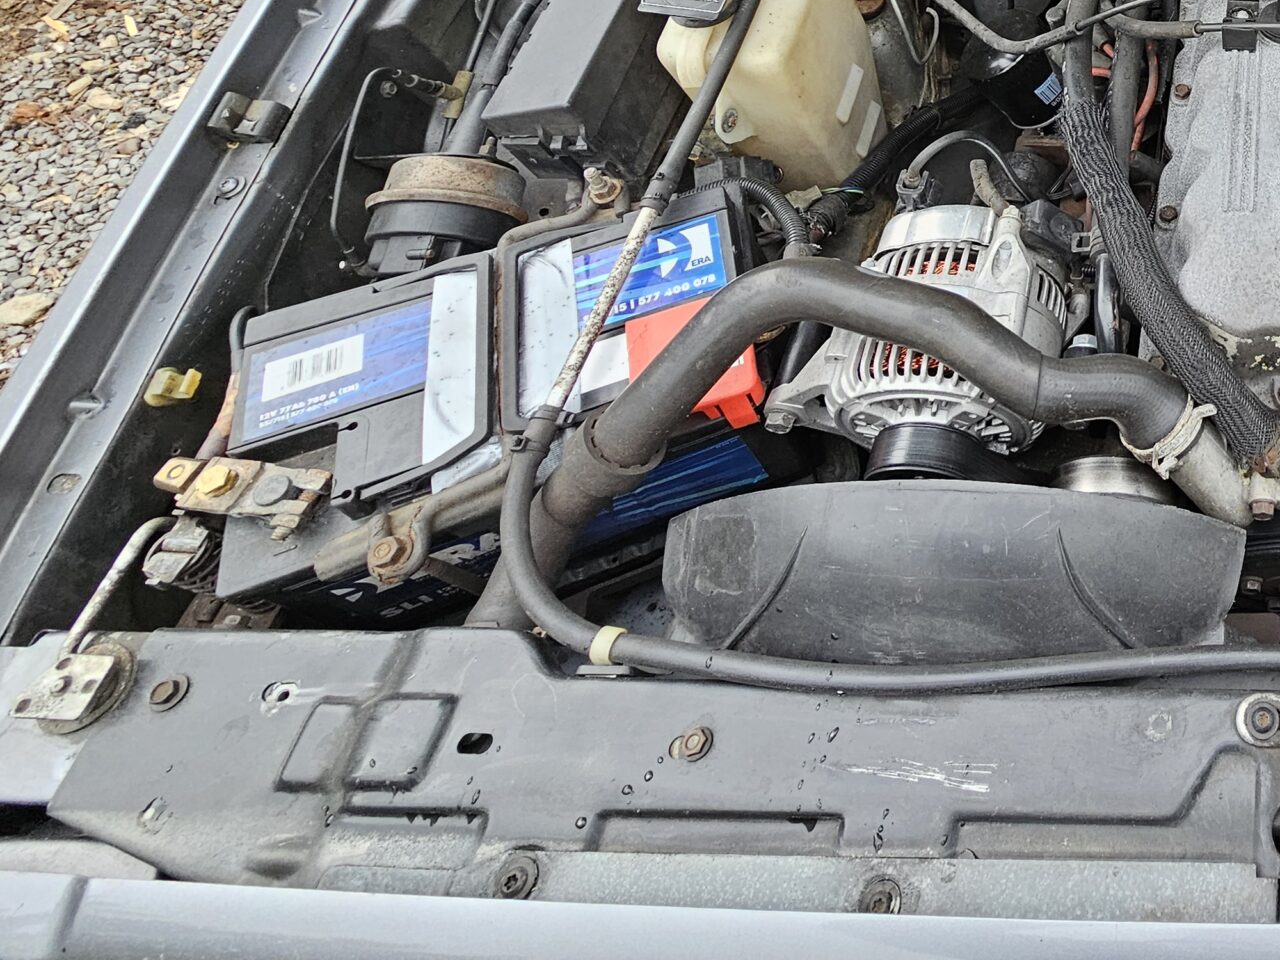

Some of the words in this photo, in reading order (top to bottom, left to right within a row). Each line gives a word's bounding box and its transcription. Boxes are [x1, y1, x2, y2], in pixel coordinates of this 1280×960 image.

[691, 255, 711, 268] ERA
[638, 290, 660, 306] 577
[664, 282, 690, 298] 400
[693, 274, 716, 288] 078
[380, 594, 433, 618] SLI
